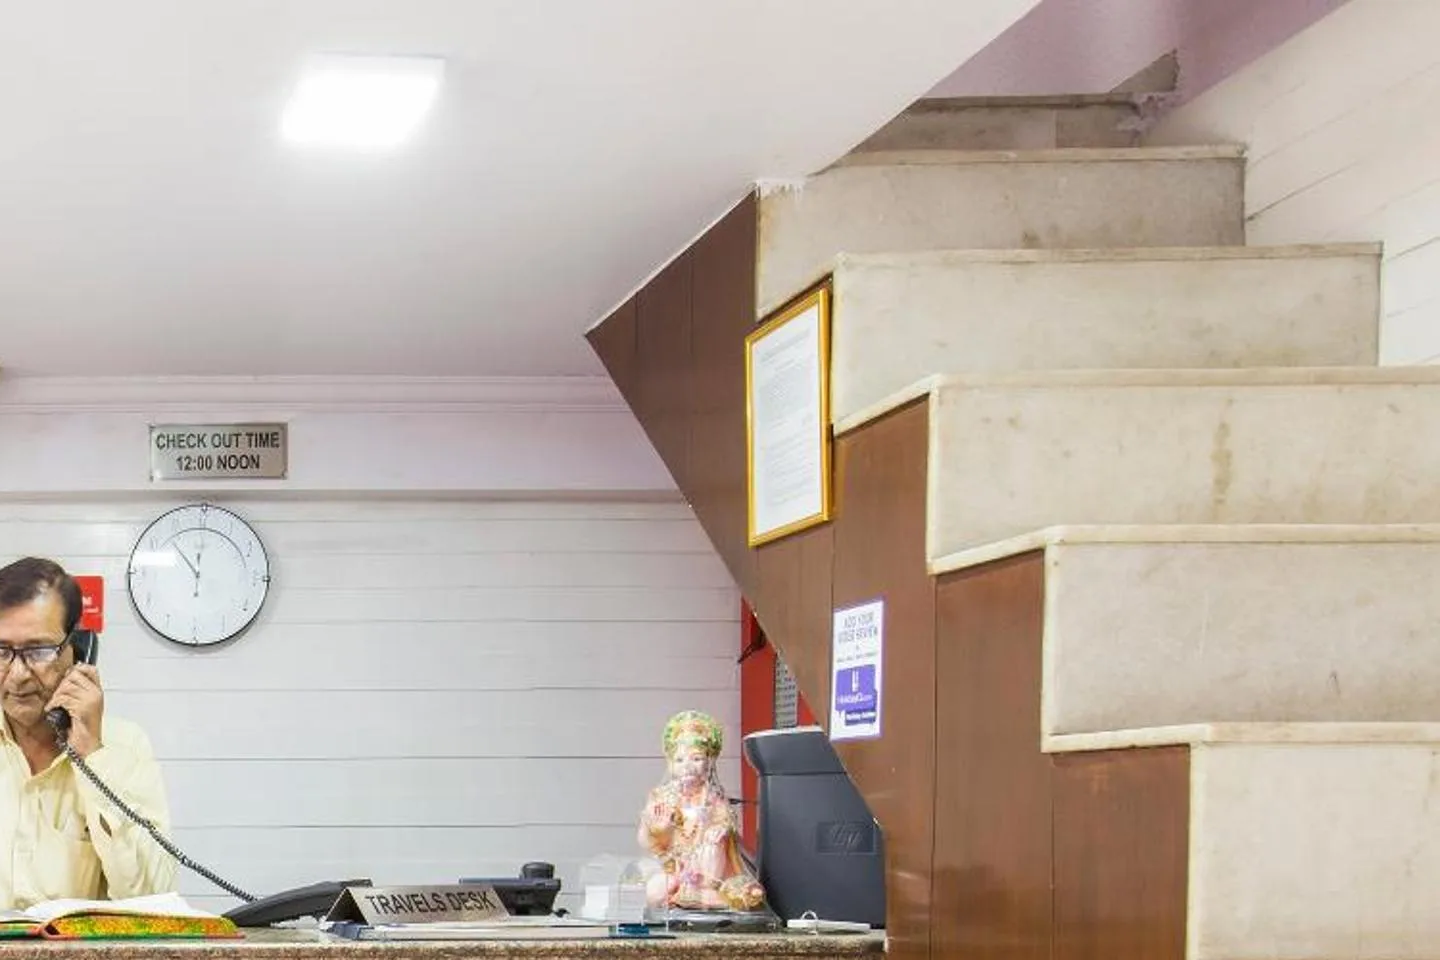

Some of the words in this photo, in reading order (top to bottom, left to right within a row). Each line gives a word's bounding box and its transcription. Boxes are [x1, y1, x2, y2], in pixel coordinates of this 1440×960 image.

[156, 433, 207, 449] CHECK
[210, 432, 242, 448] OUT
[245, 431, 280, 448] TIME
[176, 455, 213, 471] 12:00
[216, 454, 261, 470] NOON
[366, 892, 446, 915] TRAVELS
[447, 890, 497, 912] DESK
